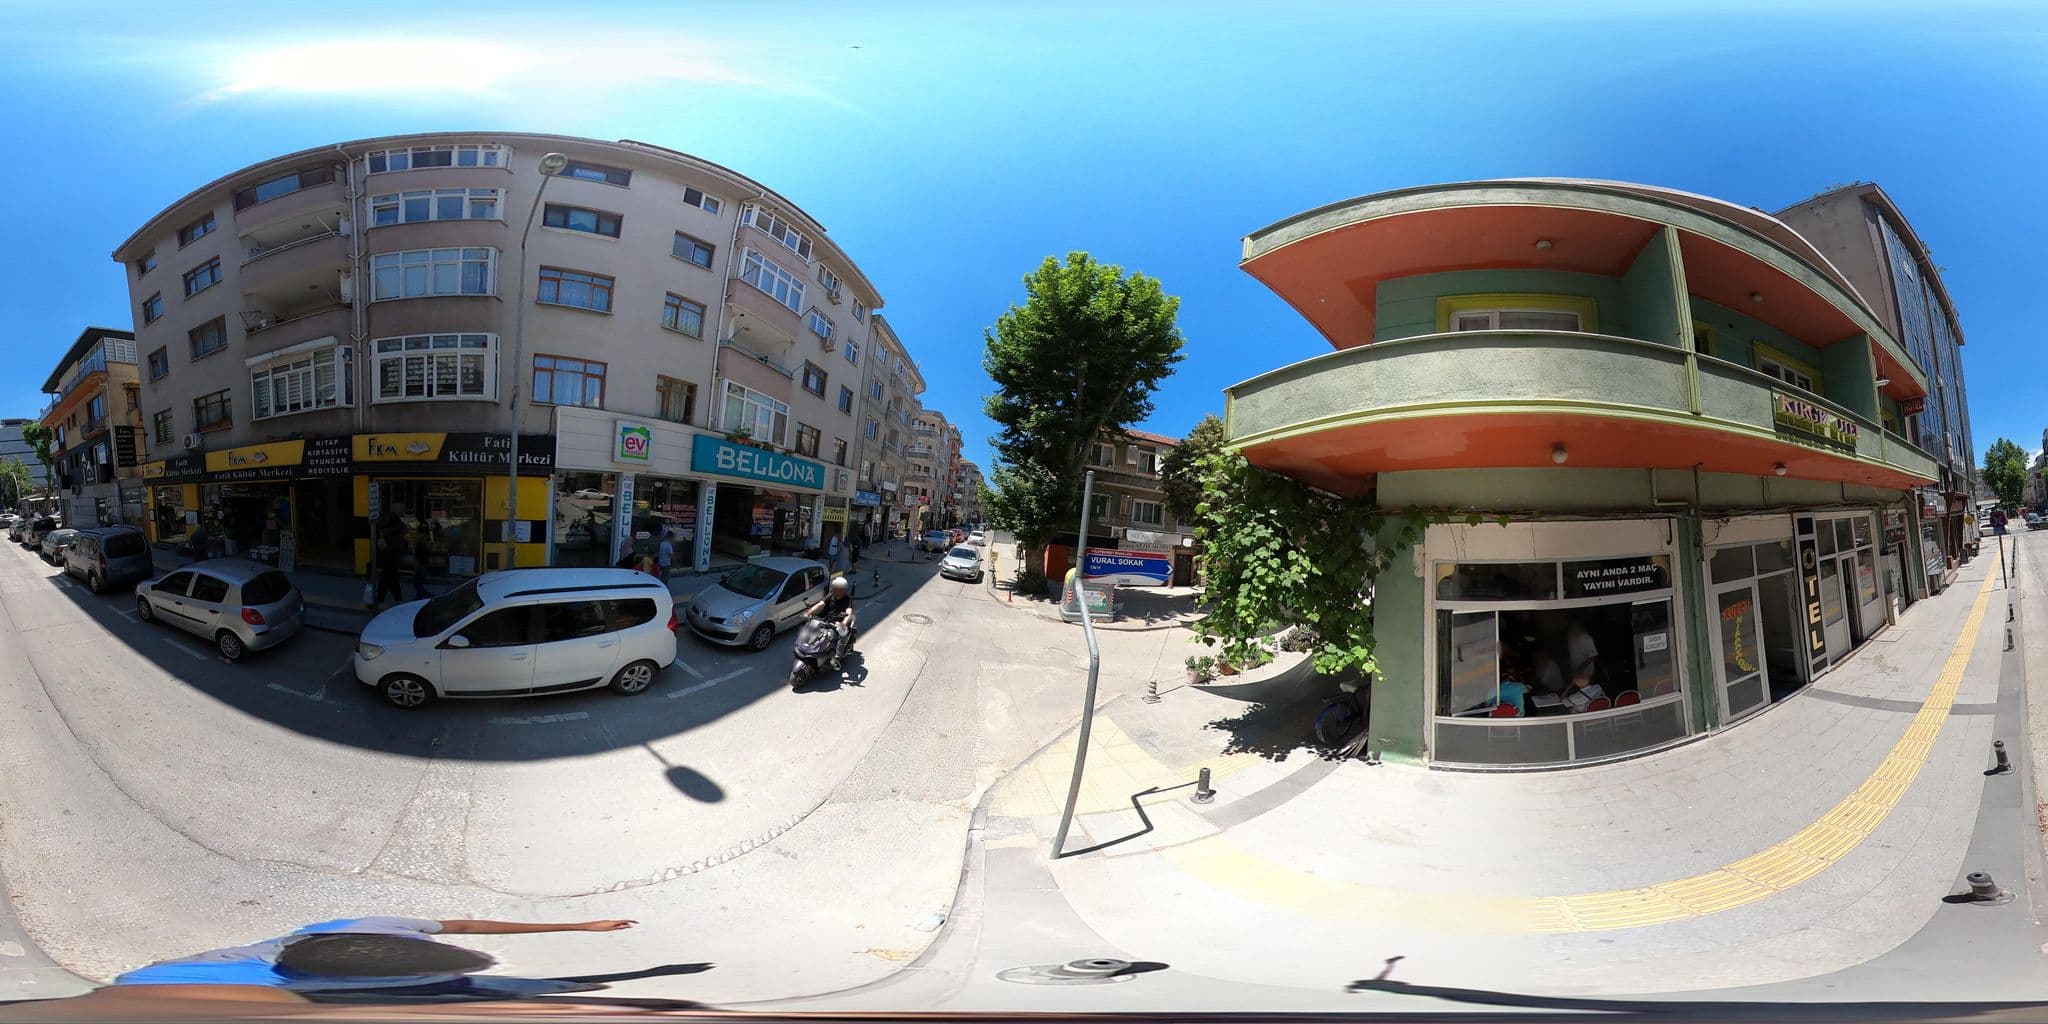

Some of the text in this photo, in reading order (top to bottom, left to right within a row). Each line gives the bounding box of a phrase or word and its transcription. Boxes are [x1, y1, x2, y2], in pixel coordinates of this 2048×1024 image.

[484, 436, 512, 449] Fati
[625, 436, 646, 451] ev
[309, 457, 347, 466] OYUNCAK
[449, 450, 551, 465] Kültür Mrkezi
[715, 445, 816, 484] BELLONA
[260, 467, 292, 477] Merkezi
[701, 495, 714, 566] BELLONA
[1091, 556, 1144, 567] VURAL SOKAK
[1577, 564, 1657, 579] AYNI ANDA 2 MAÇ
[1583, 576, 1654, 591] YAYINI VARDIR.
[1802, 547, 1824, 650] OTEL
